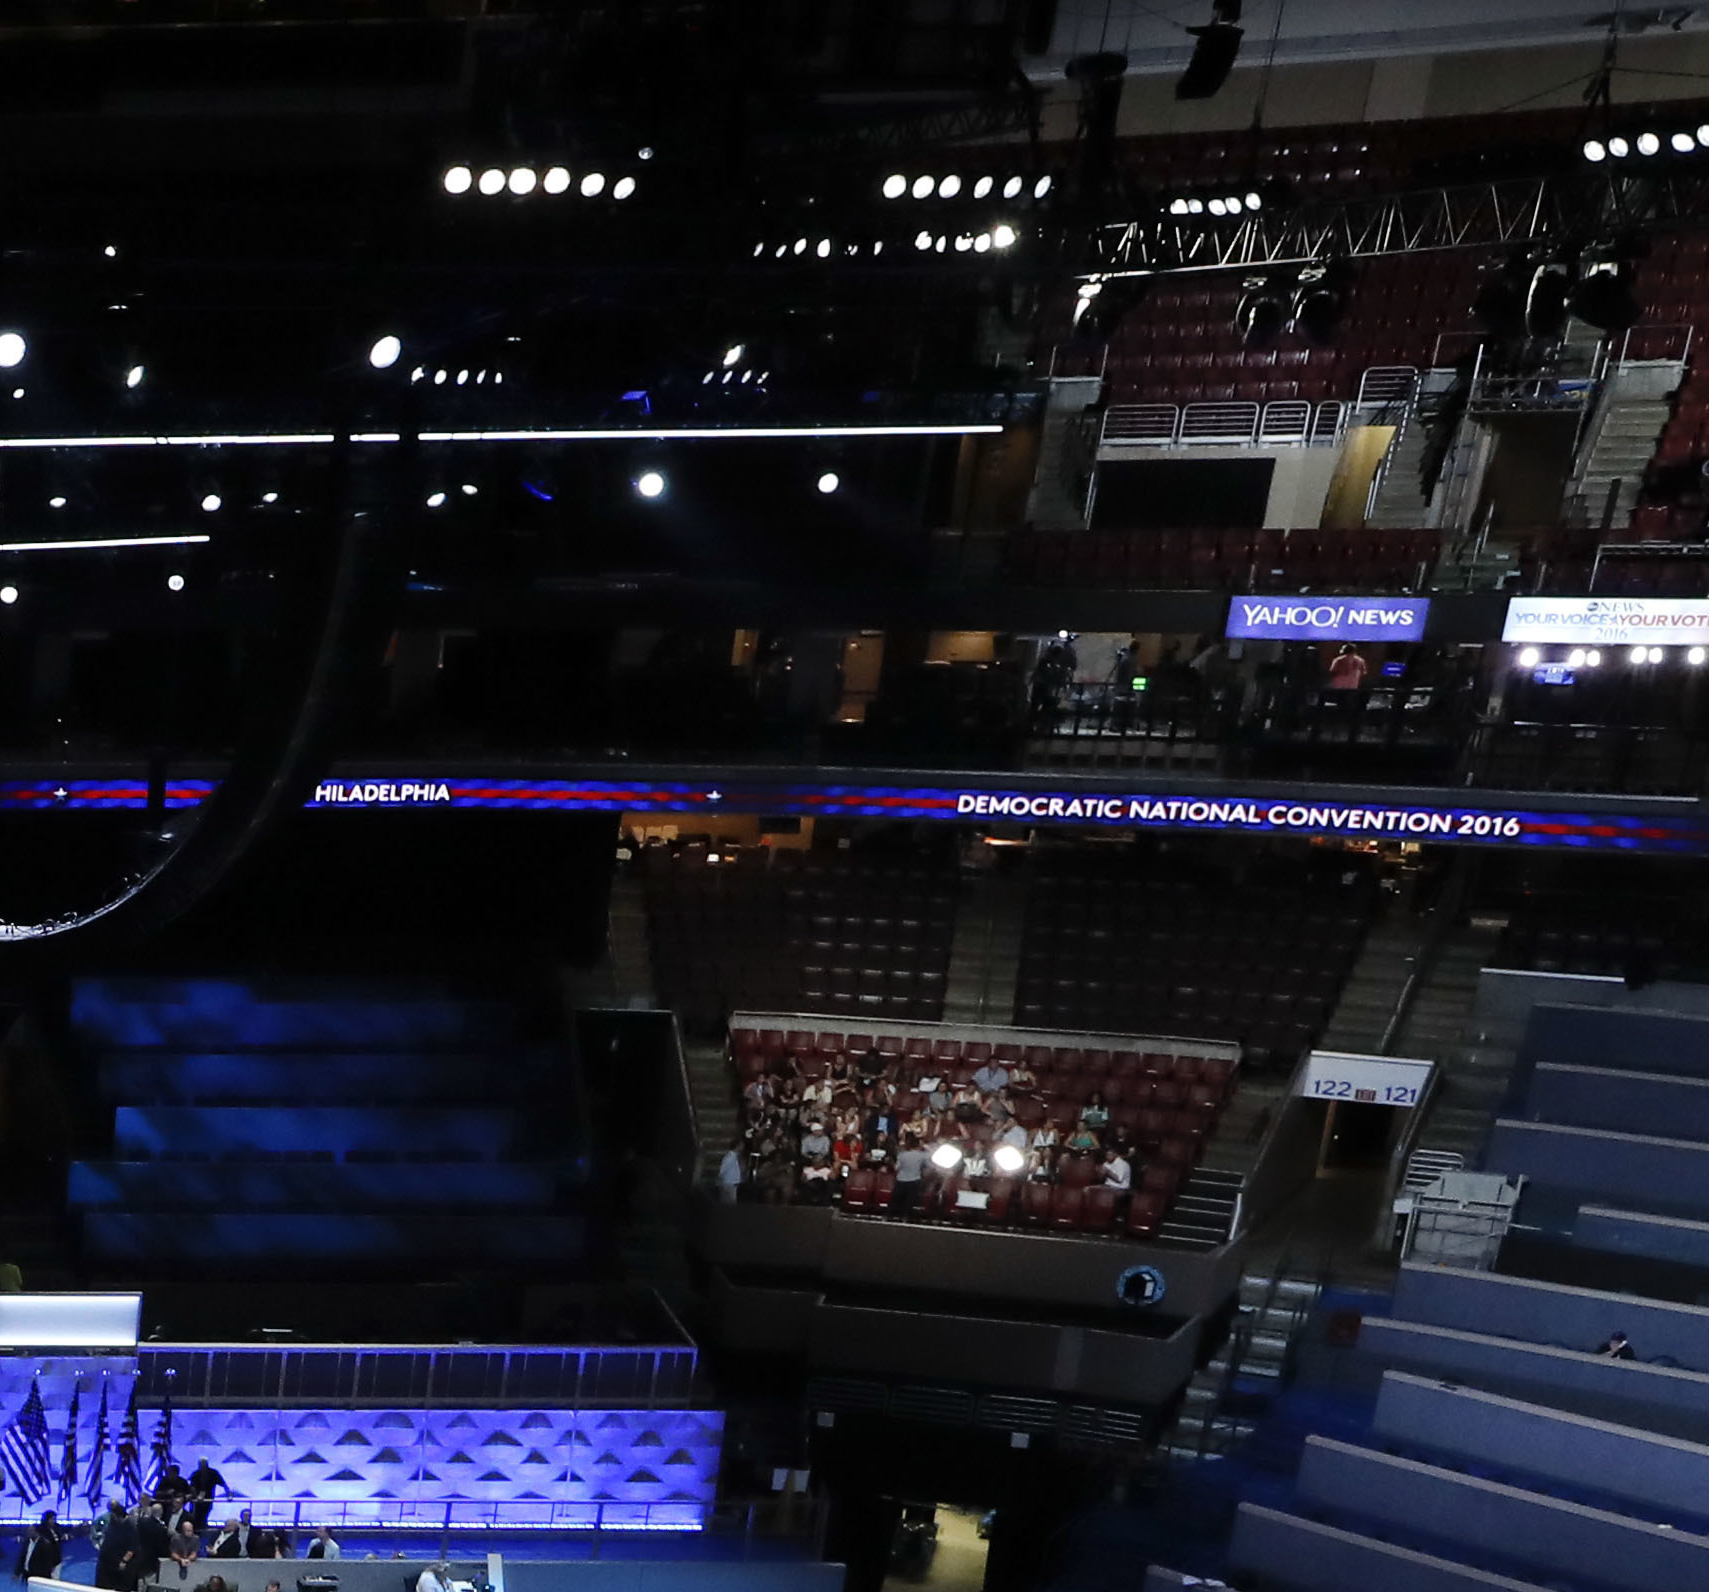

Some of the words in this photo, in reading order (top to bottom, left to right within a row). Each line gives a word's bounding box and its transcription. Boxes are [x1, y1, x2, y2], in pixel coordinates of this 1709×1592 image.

[1244, 604, 1344, 628] YAHOO!
[1348, 610, 1414, 625] NEWS
[1516, 613, 1559, 625] YOUR
[1561, 613, 1608, 625] VOICE
[1619, 614, 1668, 626] YOUR
[1595, 628, 1628, 640] 2016
[315, 785, 449, 803] HILADELPHIA
[957, 795, 1122, 819] DEMOCRATIC
[1129, 801, 1262, 825] NATIONAL
[1268, 806, 1452, 833] CONVENTION
[1457, 814, 1519, 837] 2016
[1314, 1080, 1352, 1097] 122
[1385, 1086, 1417, 1103] 121
